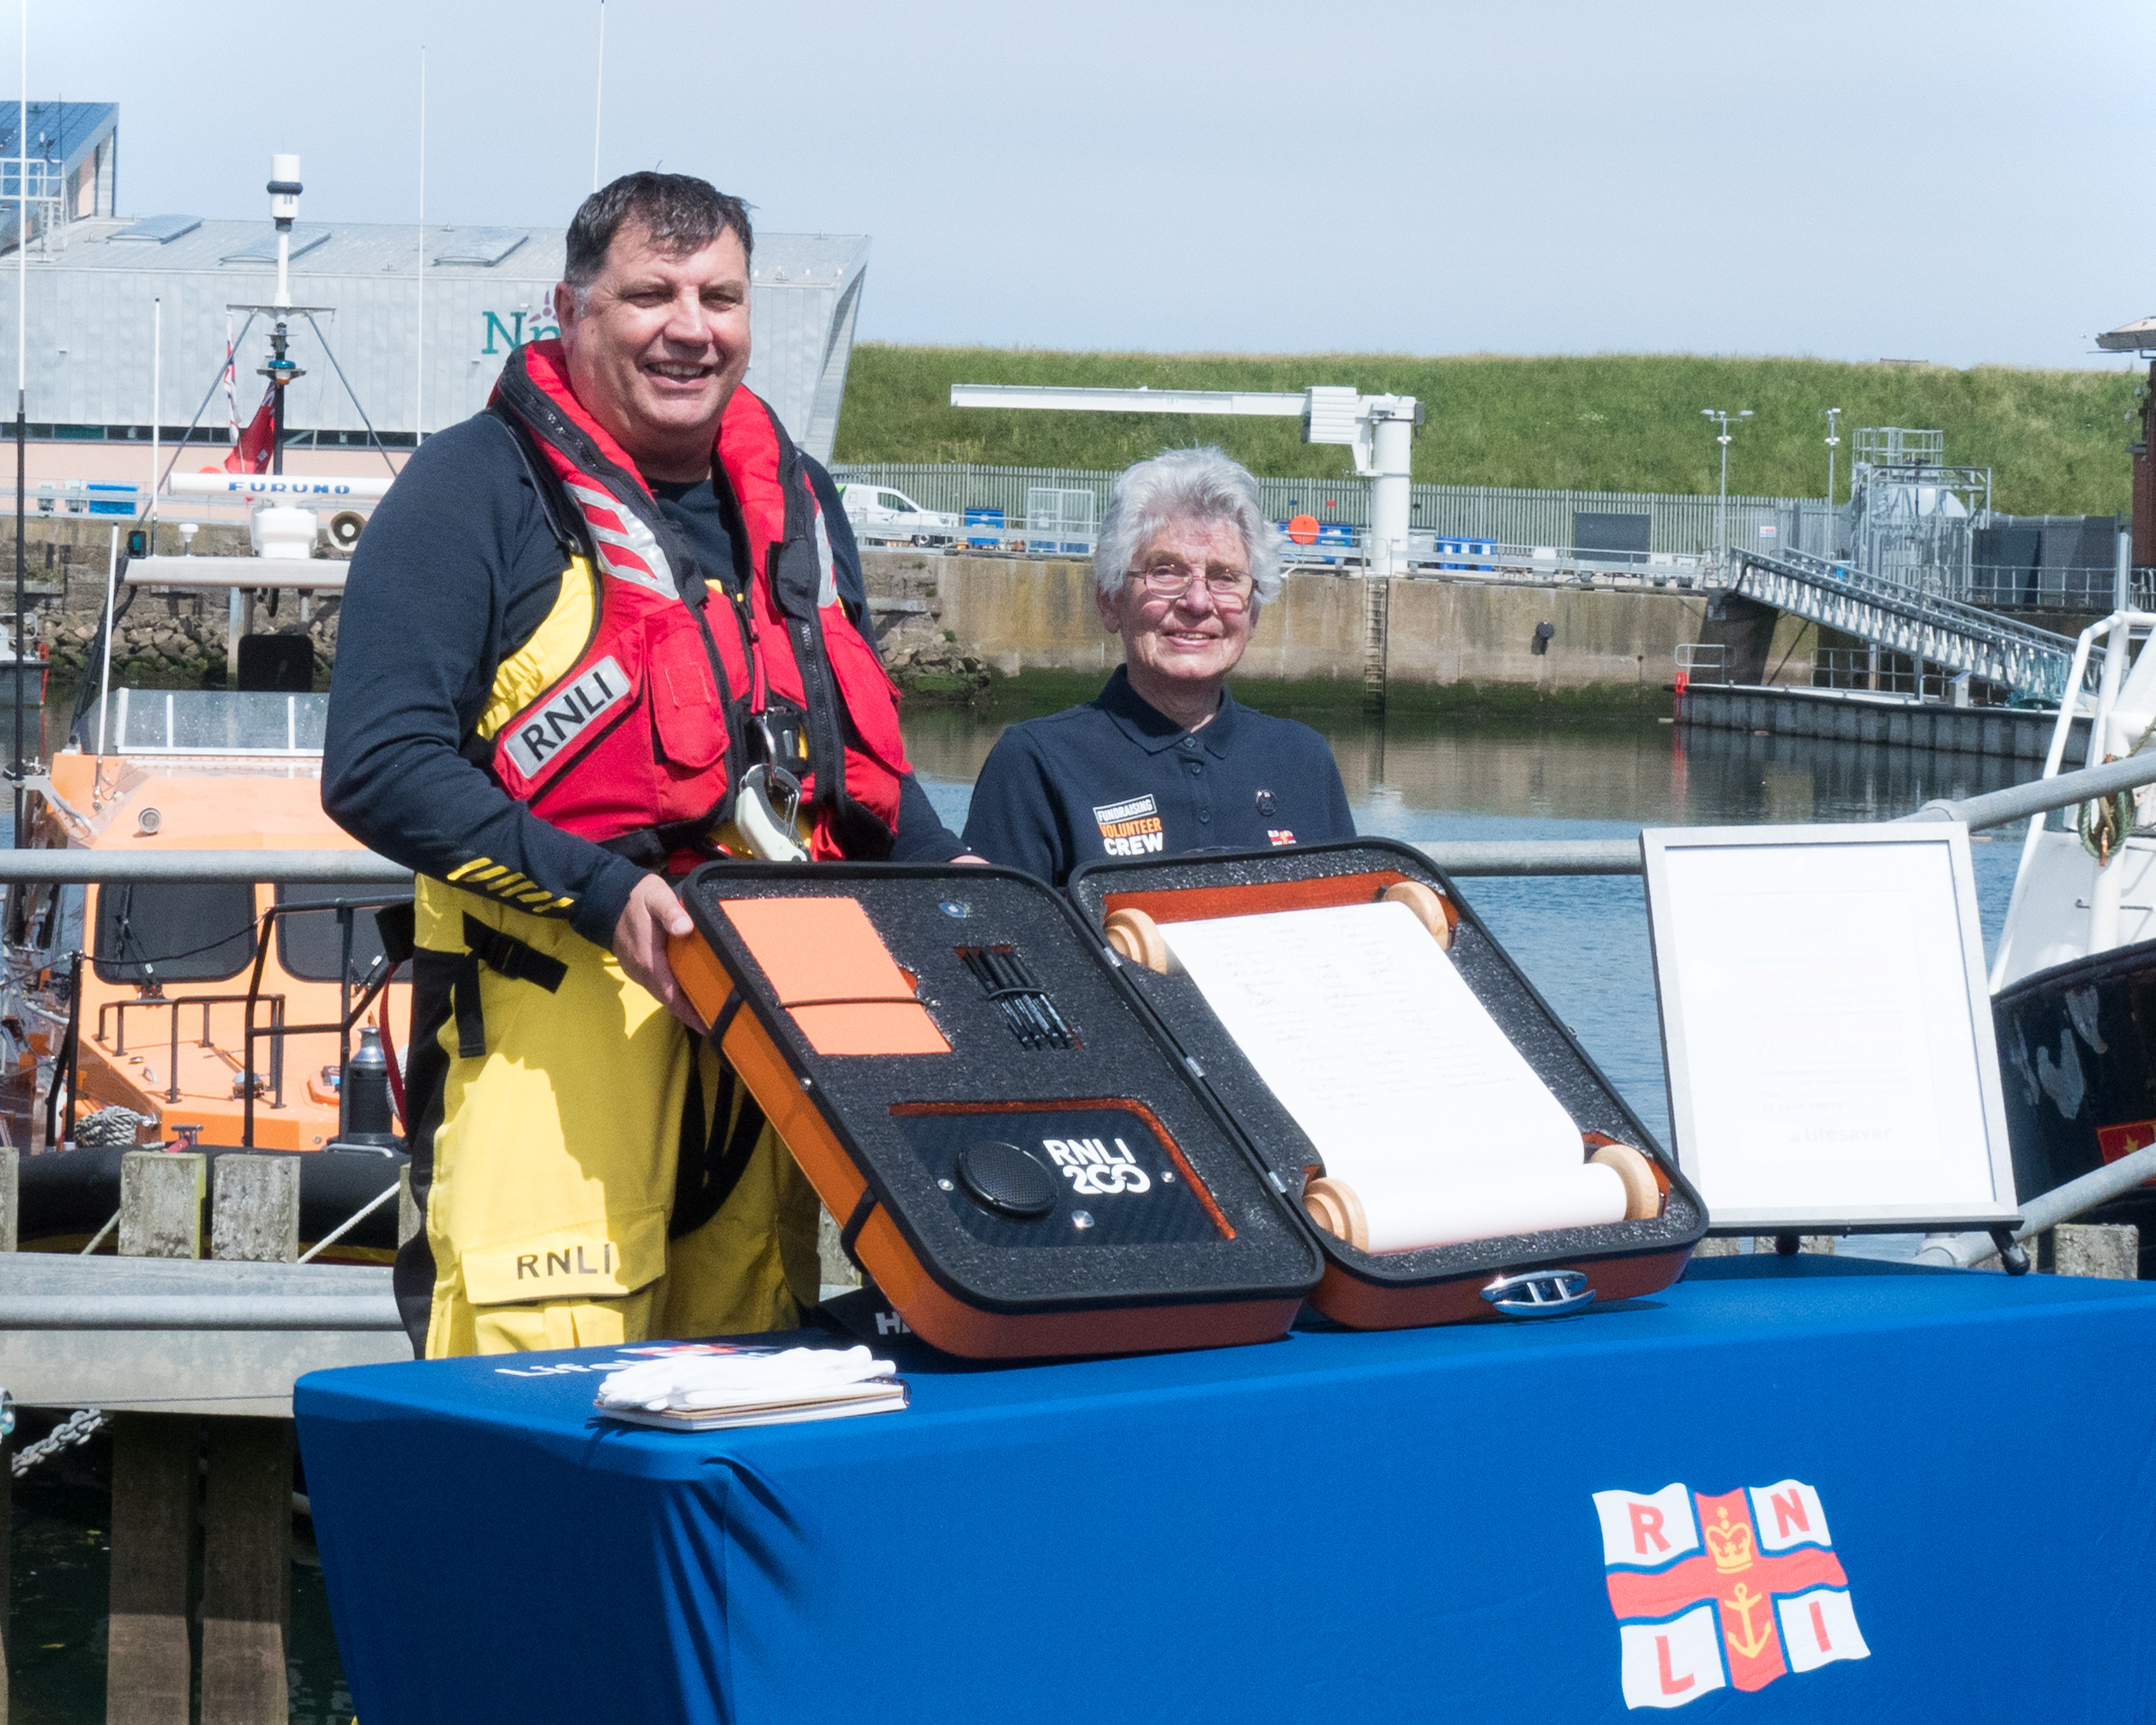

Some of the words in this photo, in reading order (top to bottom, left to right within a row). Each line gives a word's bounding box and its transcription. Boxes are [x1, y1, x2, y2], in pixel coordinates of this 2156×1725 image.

[521, 671, 615, 763] RNLI
[1097, 799, 1153, 823] FUNDRAISING
[1099, 817, 1163, 838] VOLUNTEER
[1103, 832, 1163, 856] CREW
[1788, 1129, 1802, 1143] a
[1804, 1125, 1894, 1143] lifesaver
[1043, 1138, 1136, 1165] RNLI
[1063, 1163, 1151, 1195] 200
[517, 1243, 610, 1280] RNLI
[1627, 1501, 1671, 1556] R
[1769, 1488, 1810, 1539] N
[1654, 1635, 1696, 1696] L
[1808, 1601, 1833, 1653] I
